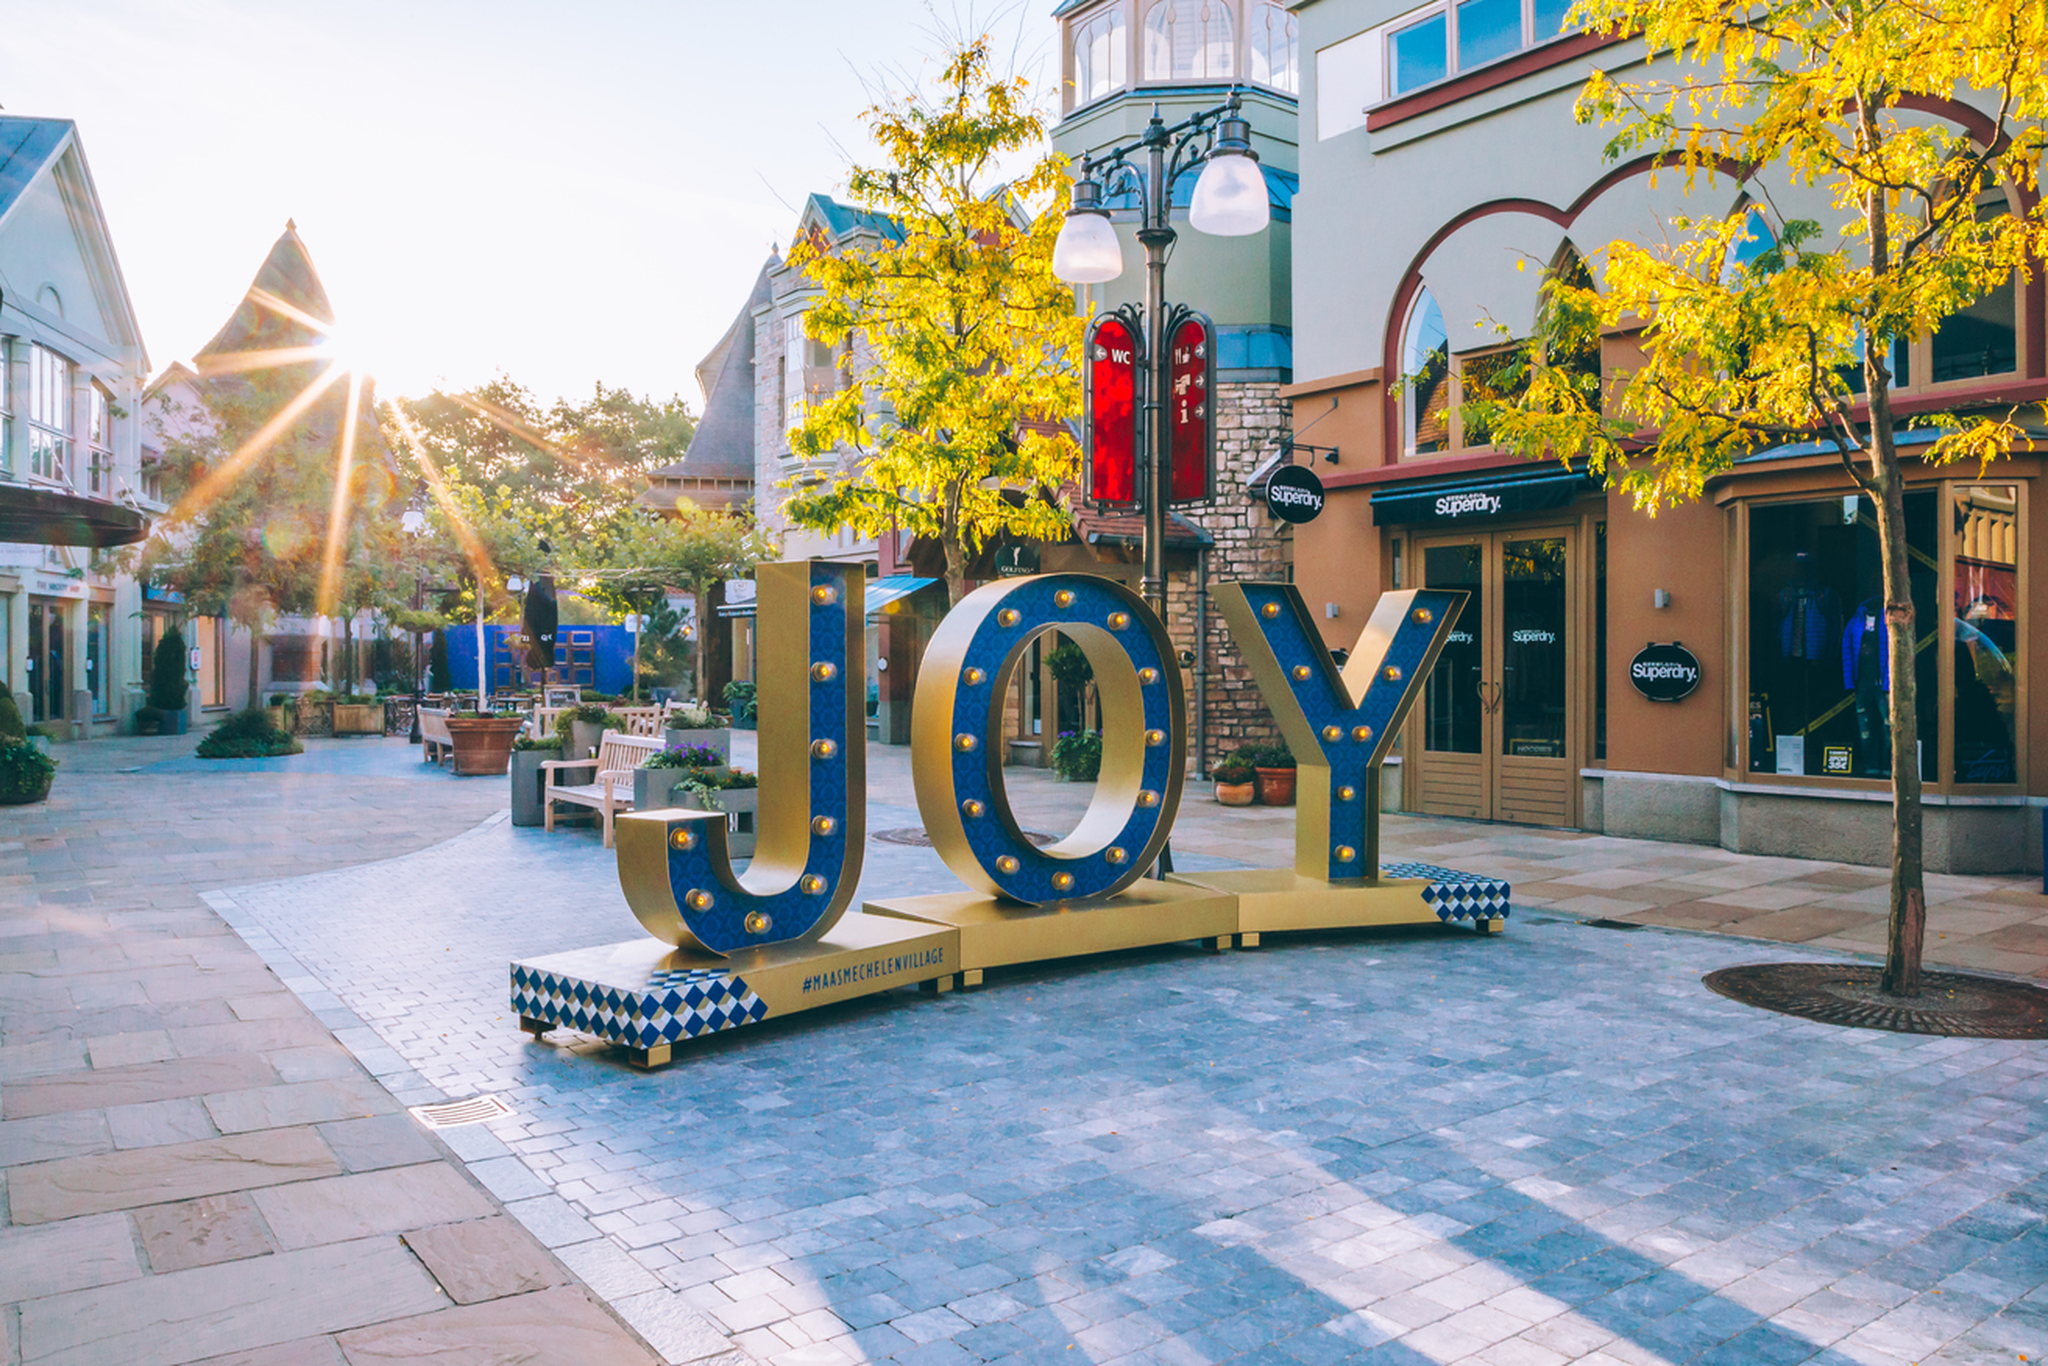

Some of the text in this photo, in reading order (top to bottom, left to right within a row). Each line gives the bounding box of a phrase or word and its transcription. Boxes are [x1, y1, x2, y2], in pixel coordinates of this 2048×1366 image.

[1111, 348, 1131, 365] WC
[1270, 485, 1322, 511] Superdry.
[1435, 493, 1502, 517] Superdry.
[1633, 662, 1697, 683] Superdry.
[617, 558, 1471, 957] JOY
[803, 947, 945, 995] #MAASMECHELENVILLAGE
